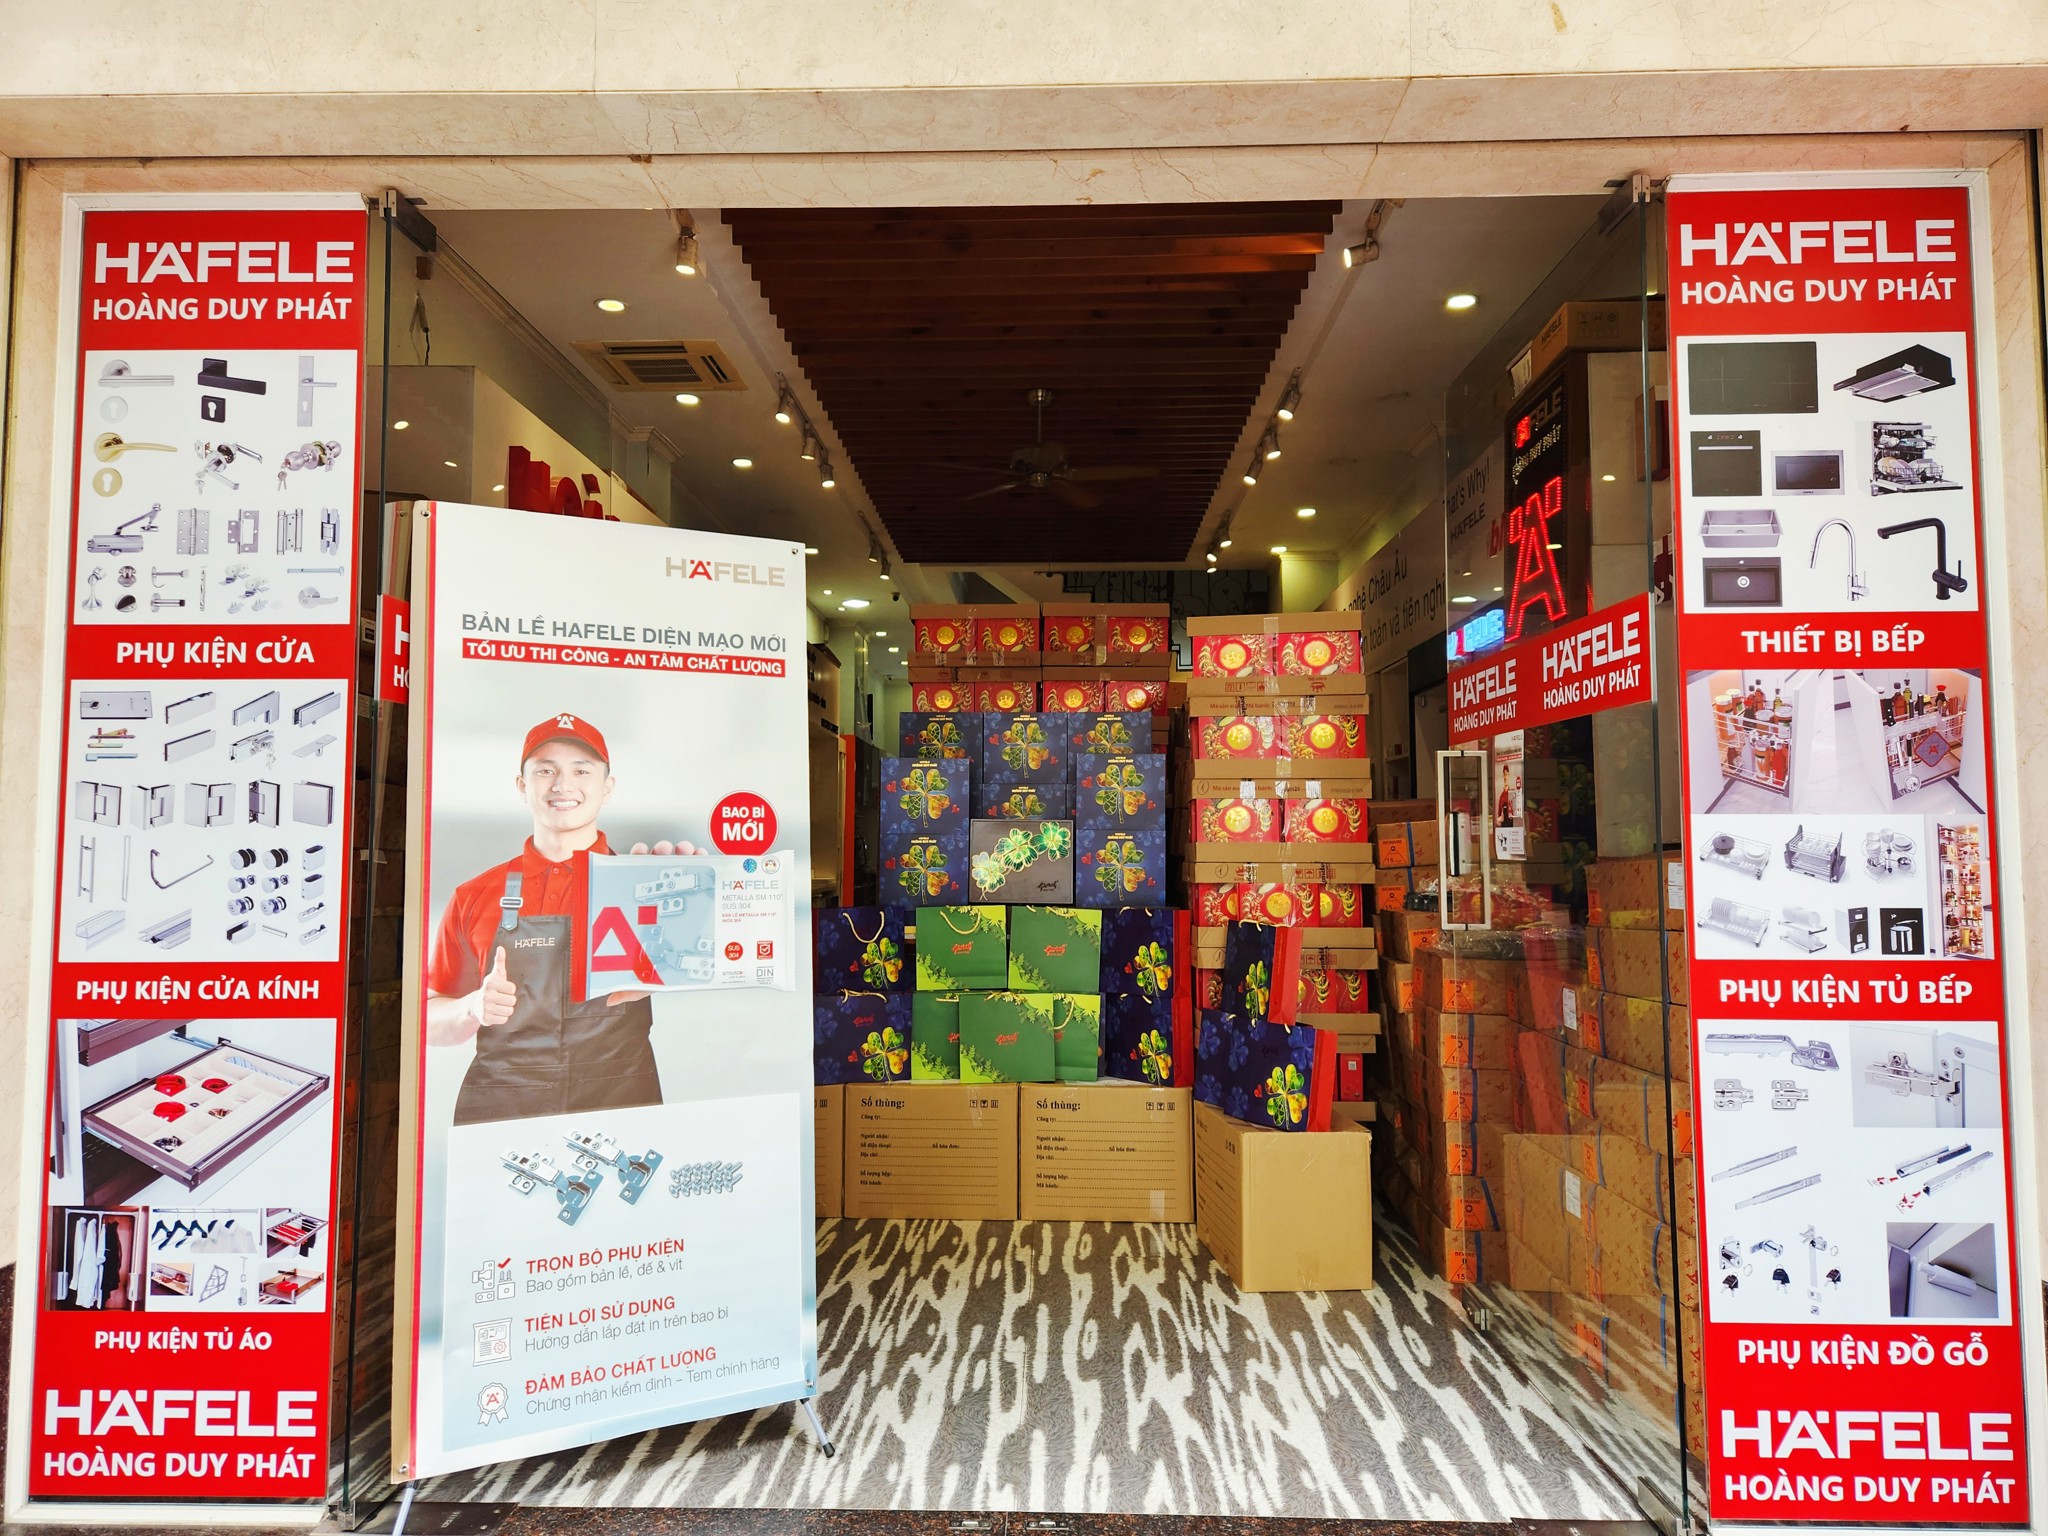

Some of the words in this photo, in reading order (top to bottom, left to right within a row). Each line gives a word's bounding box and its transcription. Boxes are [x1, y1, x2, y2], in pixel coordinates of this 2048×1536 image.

[1679, 219, 1957, 267] HÄFELE
[94, 241, 355, 284] HÄFELE
[93, 292, 200, 321] HOÀNG
[207, 298, 269, 321] DUY
[275, 291, 353, 320] PHÁT
[1681, 274, 1794, 305] HOÀNG
[1804, 278, 1868, 302] DUY
[1877, 271, 1957, 301] PHÁT
[665, 556, 786, 587] HÄFELE
[1368, 568, 1391, 605] Châu
[1394, 549, 1407, 586] Âu
[461, 611, 510, 634] BẢN
[517, 614, 545, 636] LỀ
[552, 620, 636, 643] HAFELE
[641, 626, 692, 649] DIỆN
[697, 632, 745, 652] MẠO
[749, 633, 787, 653] MỚI
[1542, 611, 1641, 683] HÄFELE
[1741, 624, 1826, 655] THIẾT
[1835, 630, 1862, 658] BỊ
[1871, 622, 1926, 653] BẾP
[116, 643, 173, 670] PHỤ
[183, 636, 249, 670] KIỆN
[255, 634, 315, 664] CỬA
[467, 640, 496, 658] TỐI
[499, 643, 527, 660] ƯU
[530, 647, 558, 661] THI
[561, 647, 609, 664] CÔNG
[624, 652, 646, 665] AN
[650, 652, 683, 668] TÂM
[686, 653, 729, 671] CHẤT
[732, 658, 783, 677] LƯỢNG
[1453, 658, 1517, 710] HÄFELE
[1543, 682, 1581, 710] HOÀNG
[1582, 676, 1606, 701] DUY
[1608, 660, 1641, 694] PHÁT
[1454, 709, 1479, 734] HOÀNG
[1479, 705, 1495, 728] DUY
[1496, 698, 1517, 723] PHÁT
[722, 807, 750, 819] BAO
[752, 804, 765, 819] BÌ
[721, 818, 765, 842] MỚI
[722, 880, 779, 890] HÄFELE
[514, 937, 556, 949] HÄFELE
[76, 980, 128, 1005] PHỤ
[135, 975, 191, 1005] KIỆN
[197, 974, 251, 1001] CỬA
[258, 975, 320, 1000] KÍNH
[757, 969, 774, 977] DIN
[1719, 979, 1782, 1009] PHỤ
[1792, 974, 1861, 1009] KIỆN
[1869, 973, 1907, 1003] TỦ
[1919, 973, 1973, 1004] BẾP
[861, 1096, 873, 1108] Số
[875, 1098, 905, 1109] thùng:
[1036, 1098, 1048, 1110] Số
[1050, 1100, 1081, 1112] thùng:
[526, 1255, 574, 1276] TRỌN
[579, 1248, 602, 1269] BỘ
[608, 1244, 642, 1266] PHỤ
[648, 1238, 685, 1260] KIỆN
[526, 1277, 553, 1294] Bao
[657, 1261, 666, 1274] &
[668, 1257, 683, 1273] vít
[524, 1312, 564, 1334] TIỆN
[569, 1307, 597, 1328] LỢI
[601, 1300, 626, 1321] SỬ
[629, 1295, 676, 1319] DỤNG
[525, 1331, 570, 1352] Hướng
[574, 1326, 599, 1344] dẫn
[649, 1318, 660, 1332] in
[663, 1312, 687, 1329] trên
[691, 1310, 714, 1325] bao
[94, 1331, 140, 1354] PHỤ
[147, 1326, 198, 1354] KIỆN
[204, 1327, 233, 1350] TỦ
[238, 1327, 273, 1351] ÁO
[1738, 1340, 1801, 1370] PHỤ
[1811, 1334, 1880, 1370] KIỆN
[1888, 1333, 1934, 1366] ĐỒ
[1943, 1332, 1989, 1367] GỖ
[525, 1374, 566, 1396] ĐẢM
[571, 1364, 606, 1388] BẢO
[611, 1355, 656, 1379] CHẤT
[660, 1346, 717, 1371] LƯỢNG
[526, 1395, 571, 1416] Chứng
[574, 1387, 608, 1406] nhận
[645, 1375, 672, 1392] định
[686, 1369, 712, 1383] Tem
[715, 1361, 748, 1379] chính
[44, 1389, 318, 1437] HÄFELE
[1721, 1409, 2014, 1461] HÄFELE
[43, 1446, 156, 1477] HOÀNG
[165, 1453, 228, 1478] DUY
[236, 1447, 316, 1479] PHÁT
[1725, 1468, 1844, 1502] HOÀNG
[1855, 1477, 1921, 1503] DUY
[1931, 1471, 2016, 1504] PHÁT
